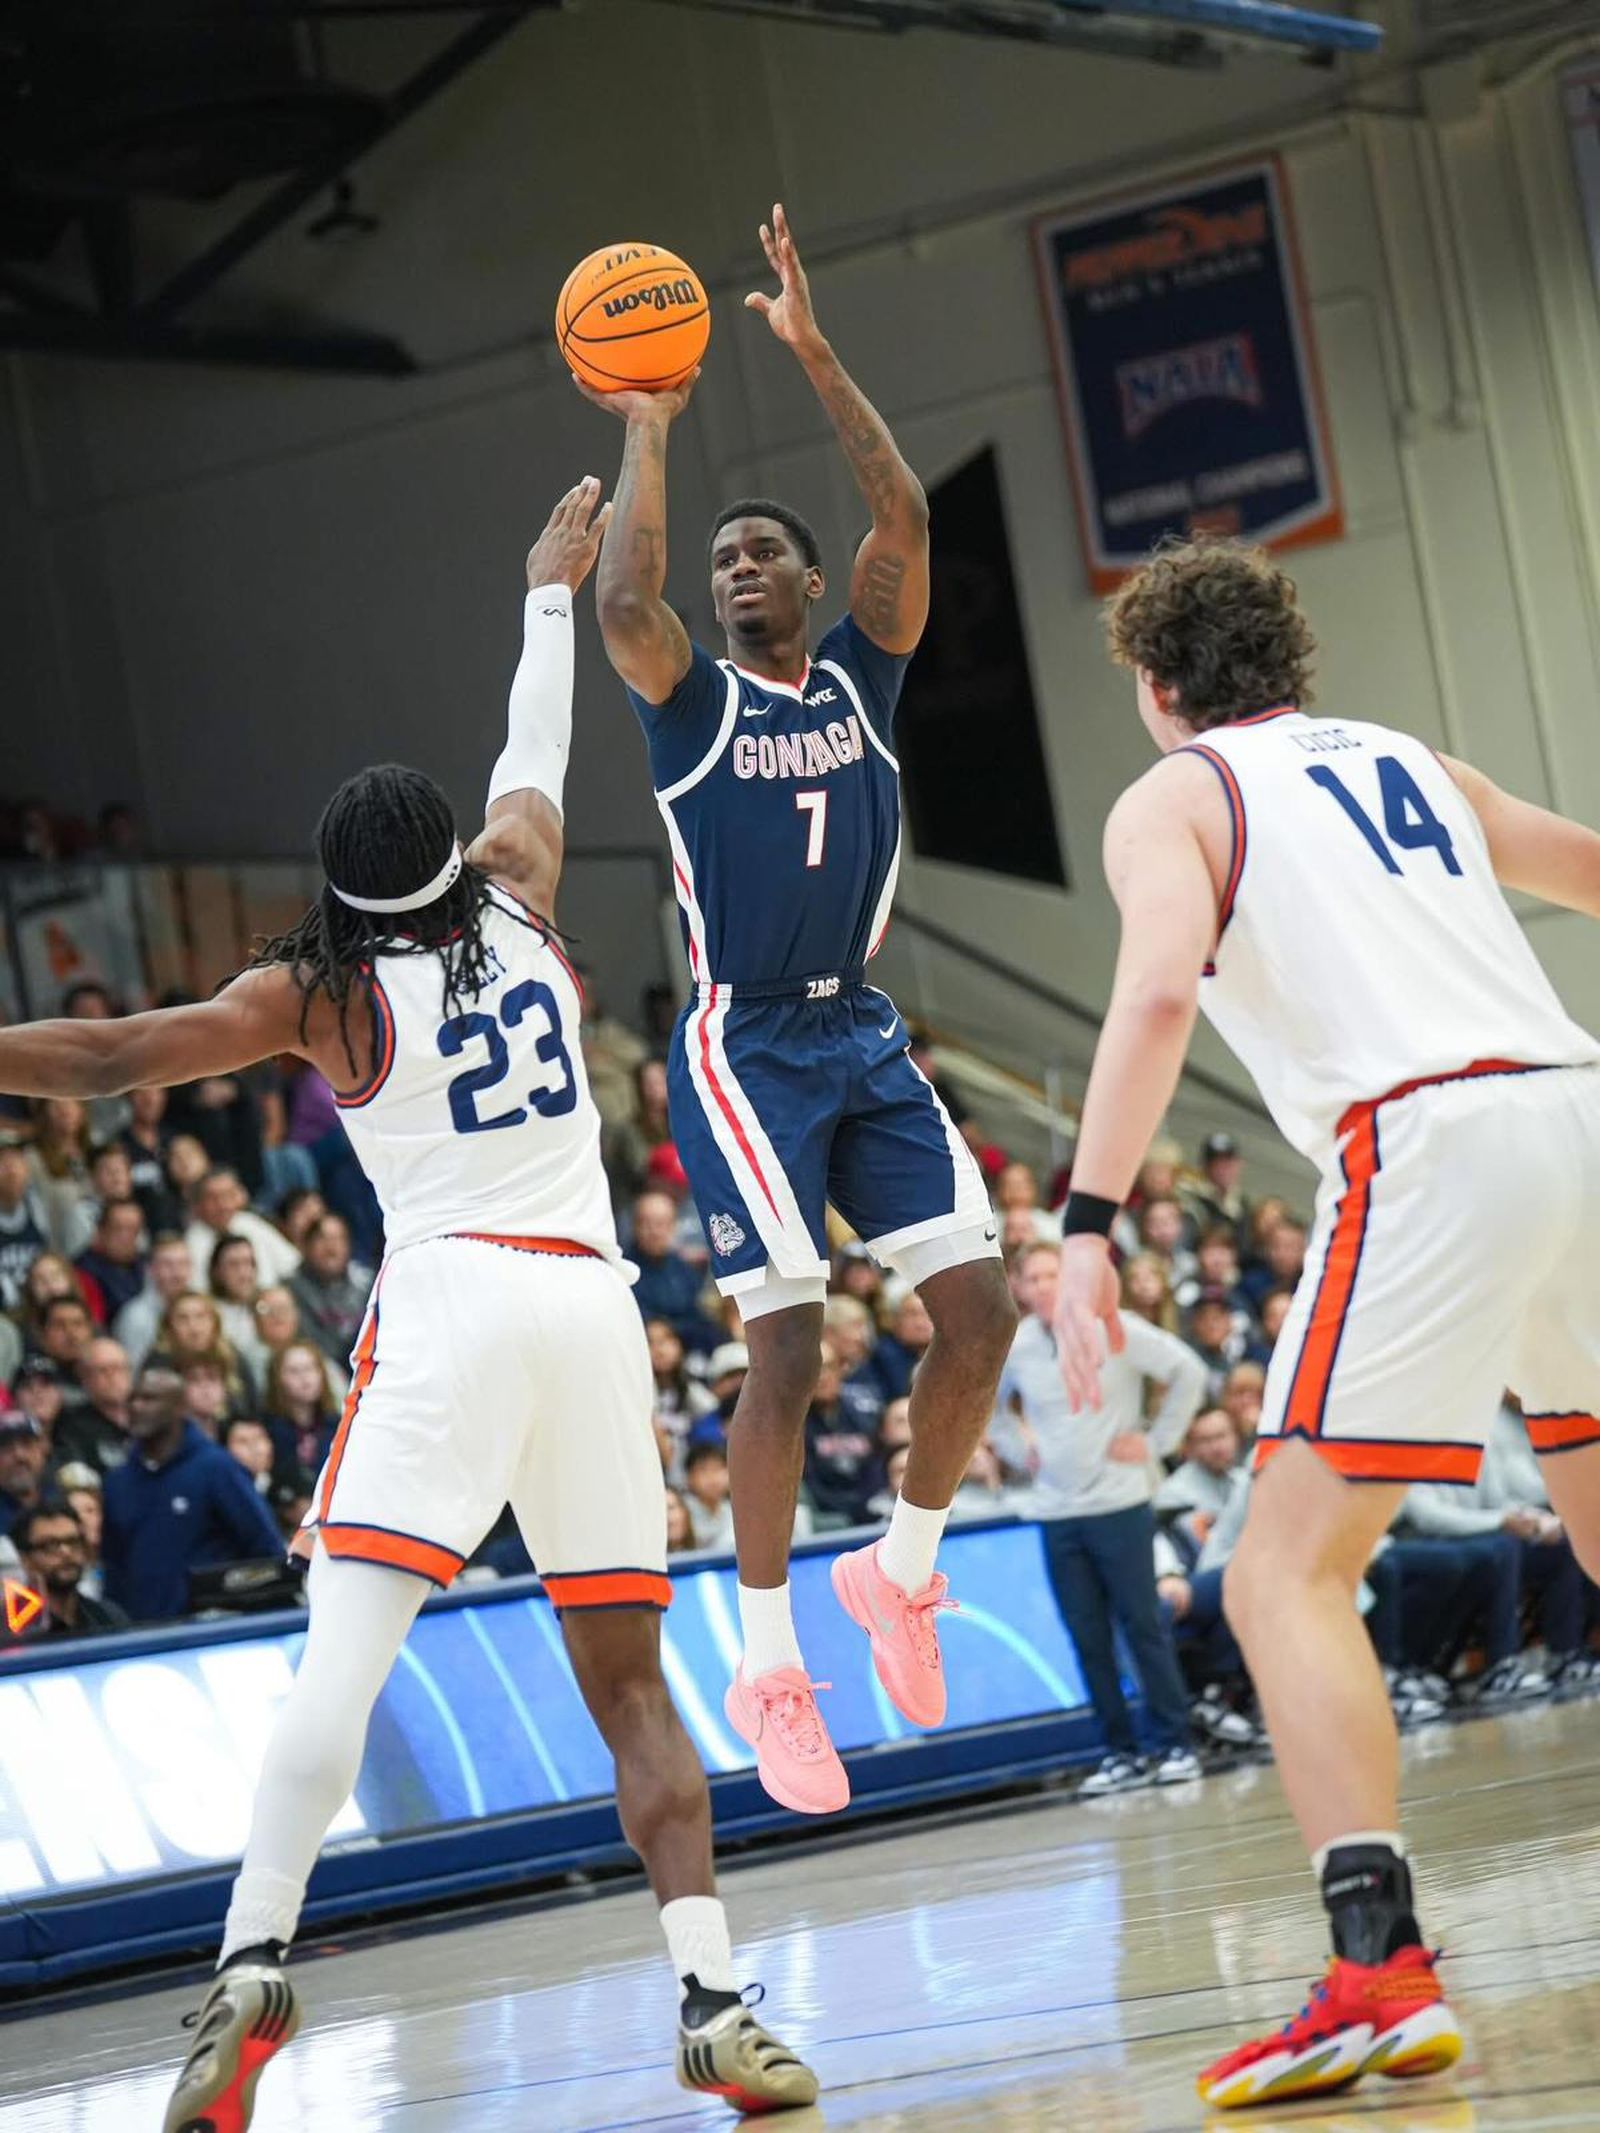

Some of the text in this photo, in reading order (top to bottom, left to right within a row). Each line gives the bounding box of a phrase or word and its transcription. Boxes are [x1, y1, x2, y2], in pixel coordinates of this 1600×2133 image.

[602, 279, 699, 318] Wilson
[733, 715, 865, 780] GONZAGA
[796, 790, 828, 867] 7
[1305, 756, 1464, 877] 14
[807, 977, 840, 999] ZAGS
[437, 979, 577, 1133] 23
